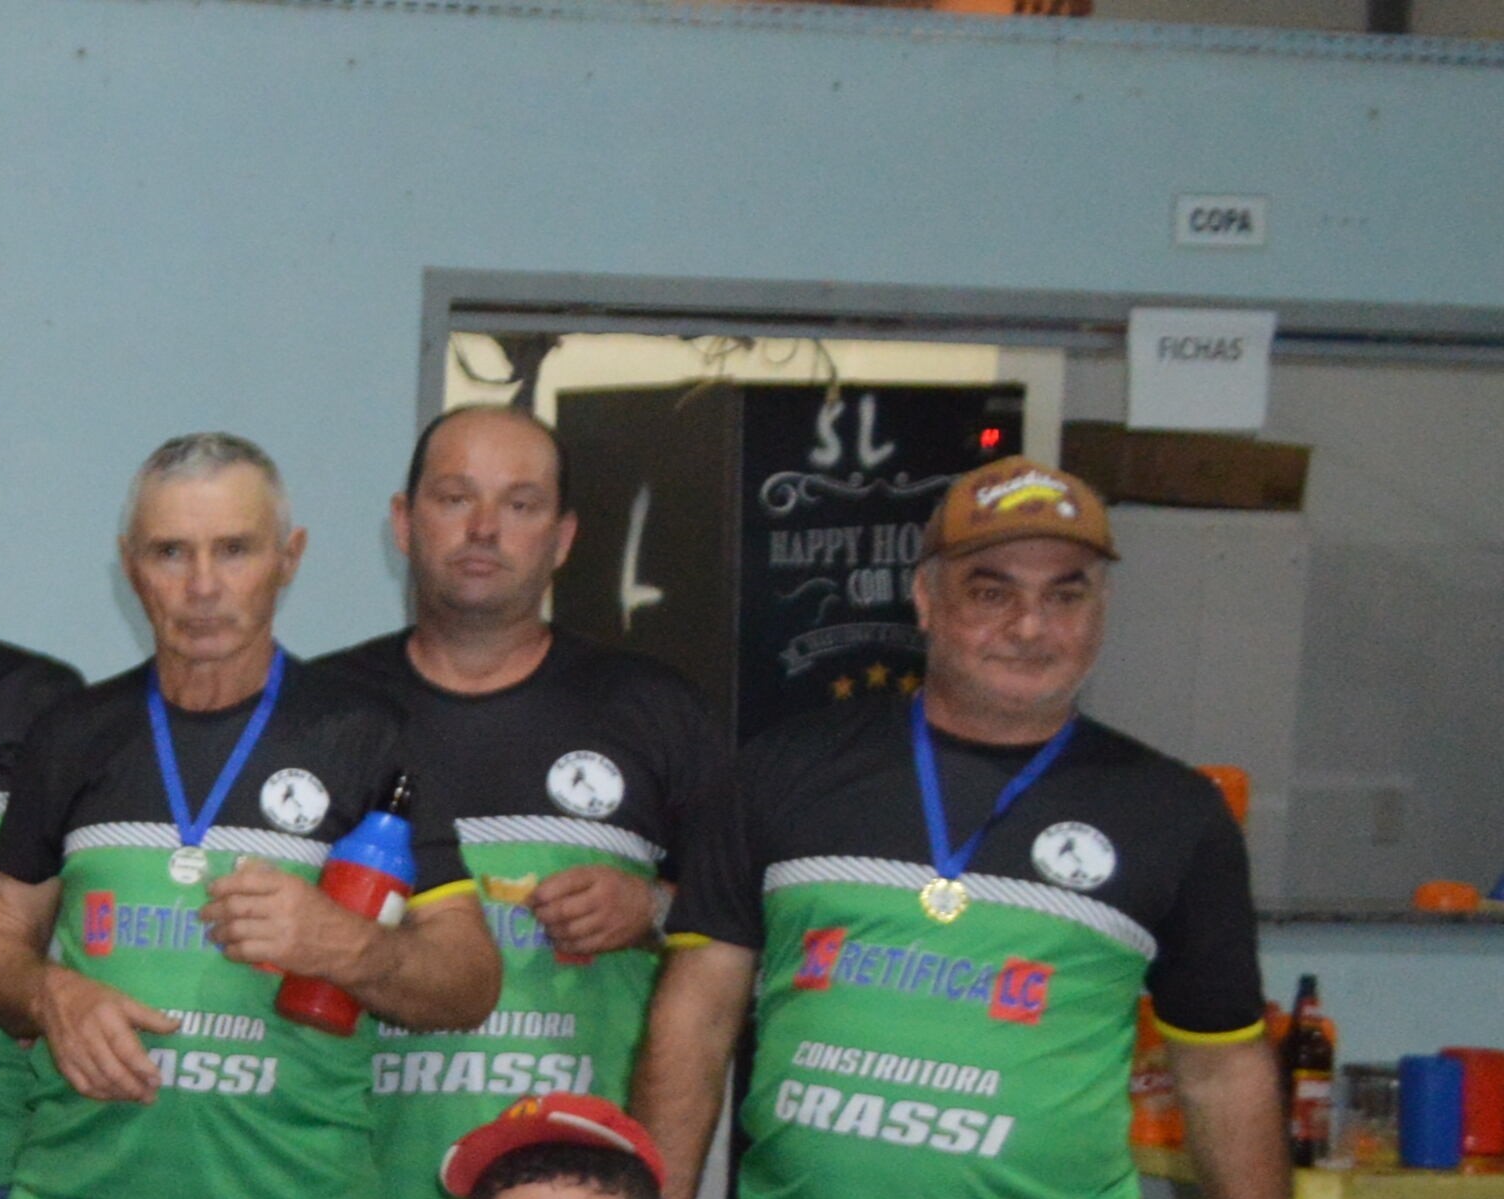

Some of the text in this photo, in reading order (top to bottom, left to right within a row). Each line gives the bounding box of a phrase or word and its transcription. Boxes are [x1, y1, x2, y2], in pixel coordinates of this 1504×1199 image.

[1190, 208, 1252, 232] COPA
[1159, 336, 1243, 360] FICHAS
[770, 526, 862, 567] HAPPY
[833, 940, 996, 1004] RETÍFICA
[999, 970, 1047, 1011] LC
[372, 1052, 593, 1094] GRASSI
[792, 1041, 1001, 1097] CONSTRUTORA
[775, 1079, 1015, 1158] GRASSI
